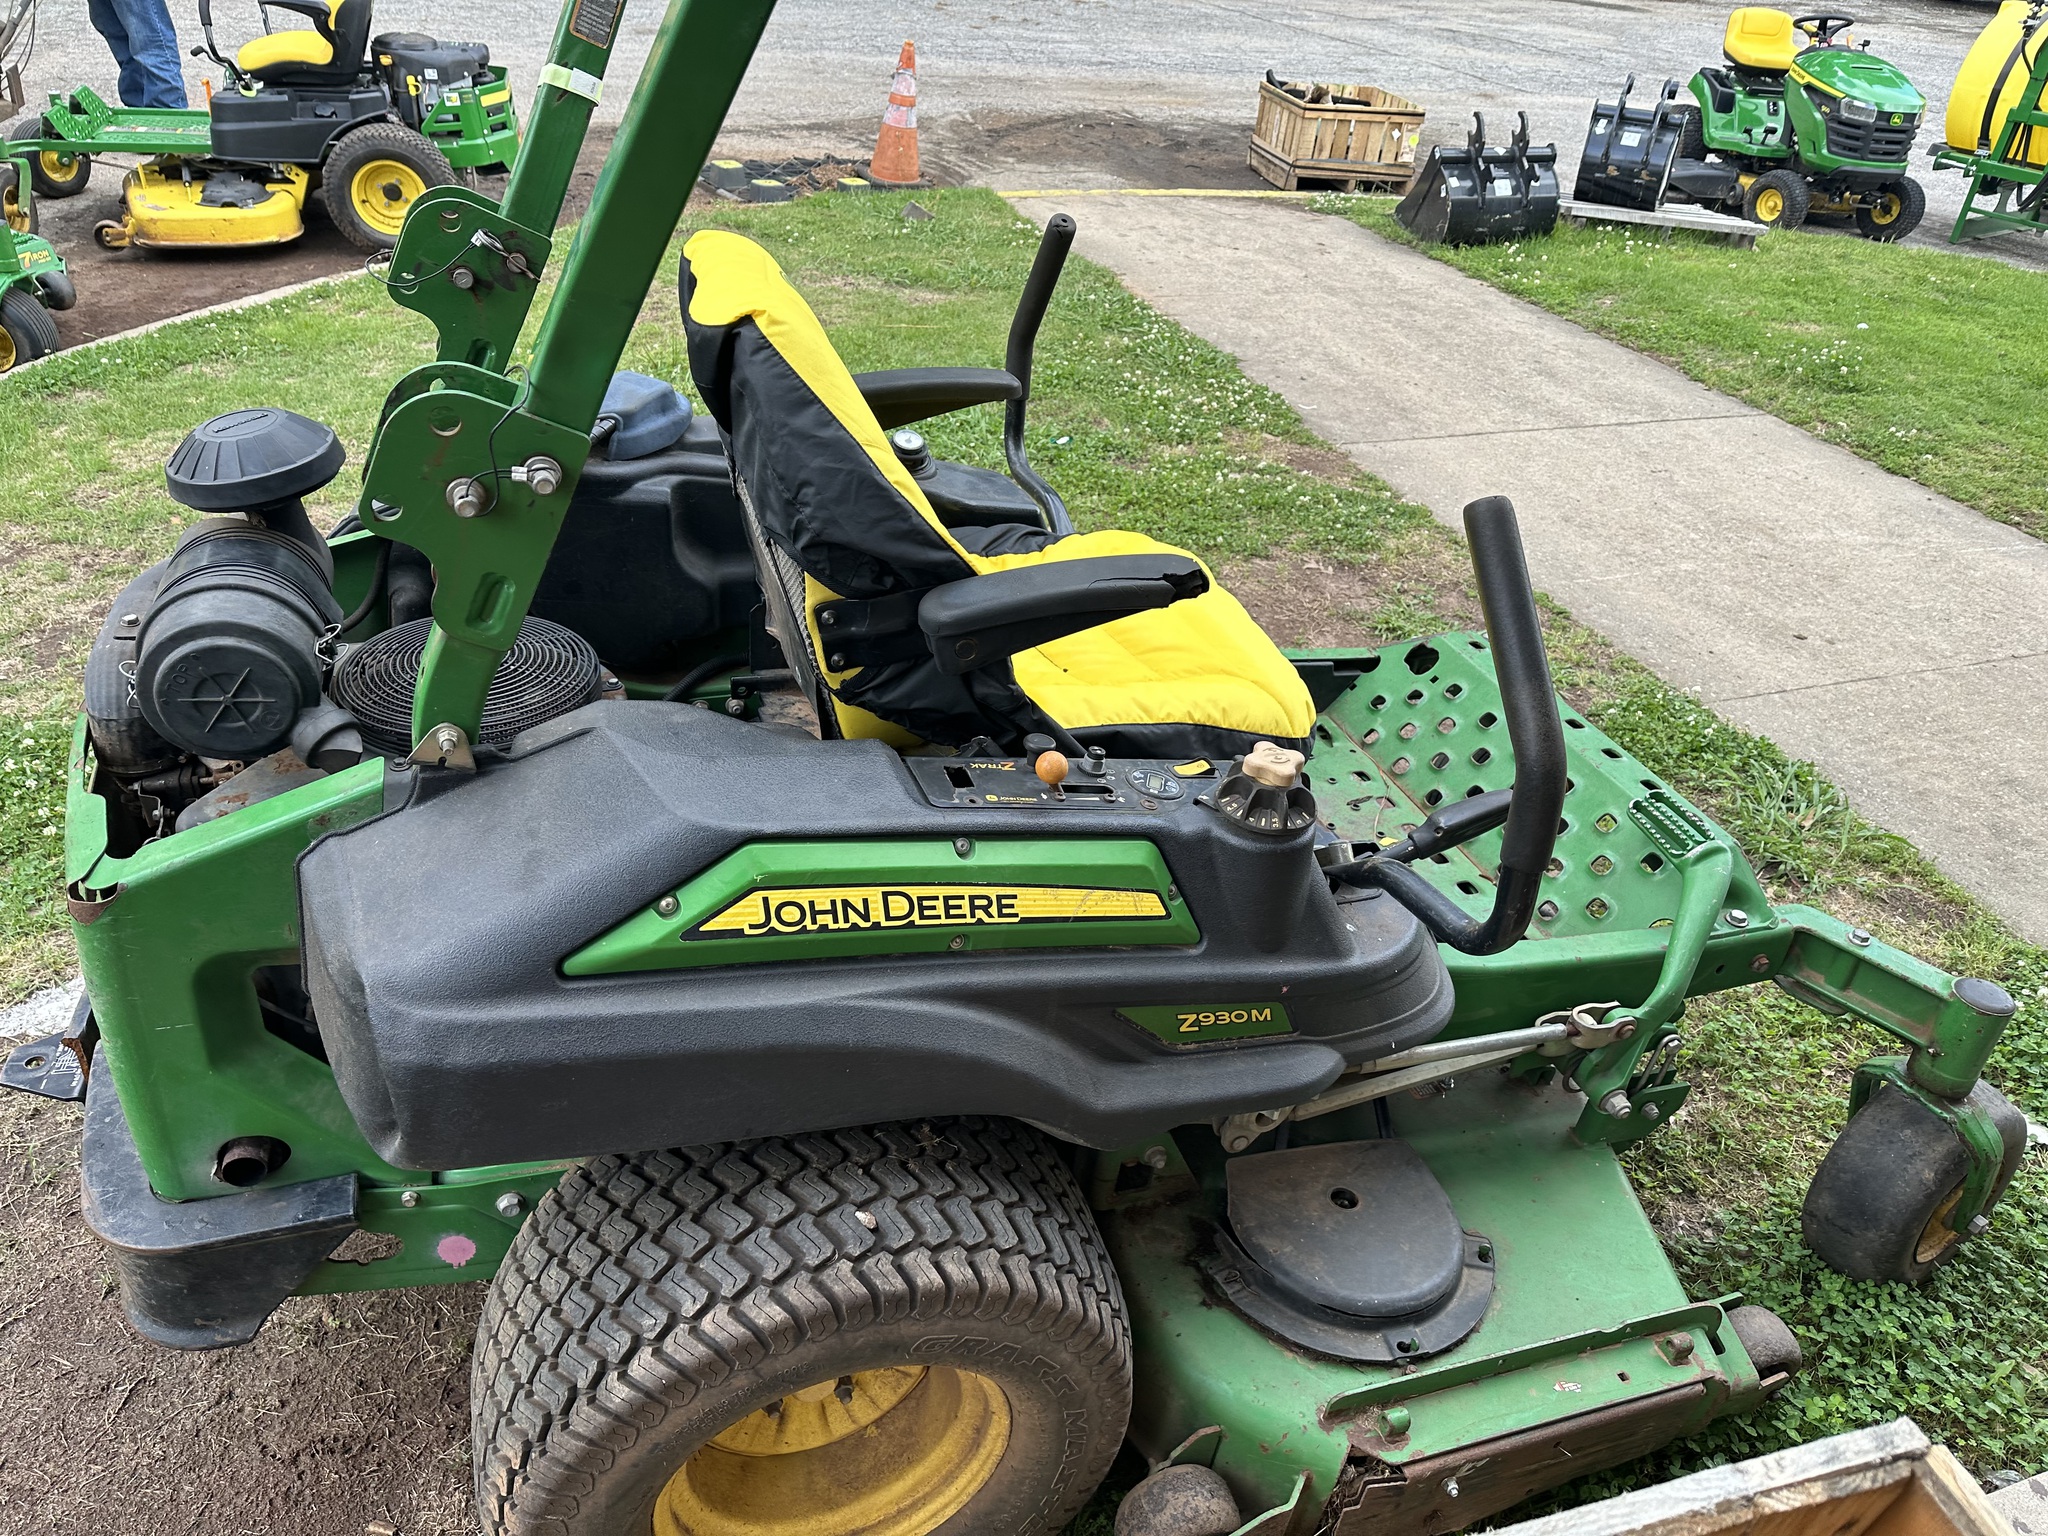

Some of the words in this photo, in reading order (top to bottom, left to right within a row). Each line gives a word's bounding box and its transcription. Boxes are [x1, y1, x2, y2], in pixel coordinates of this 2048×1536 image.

[165, 663, 200, 693] TOP
[969, 762, 1016, 770] ZTRAK
[748, 892, 871, 931] JOHN
[881, 889, 1020, 922] DEERE
[1177, 1007, 1273, 1033] Z930M
